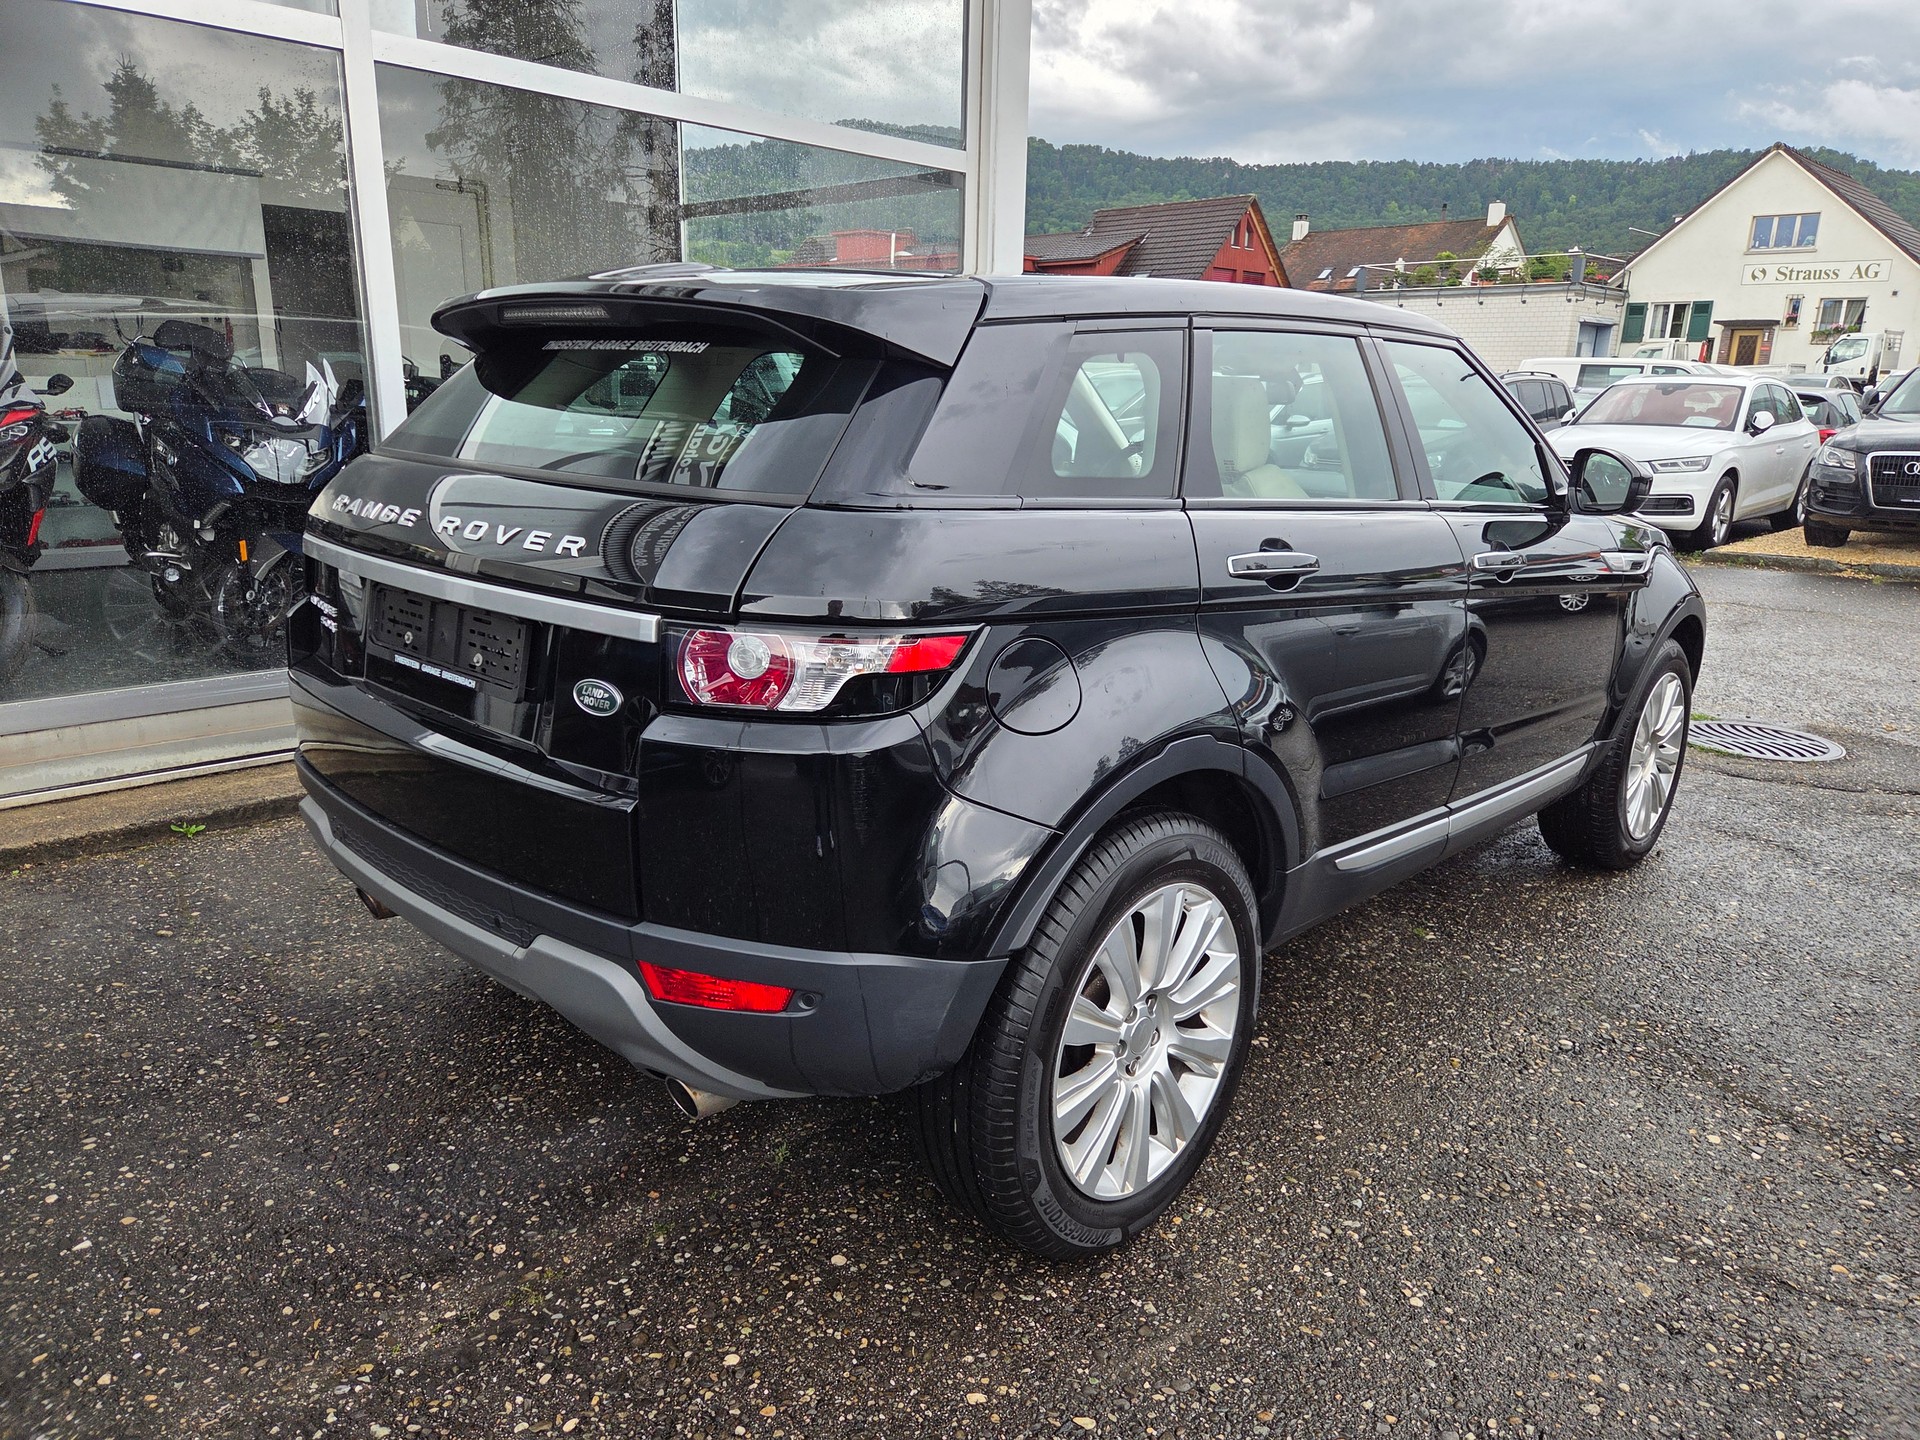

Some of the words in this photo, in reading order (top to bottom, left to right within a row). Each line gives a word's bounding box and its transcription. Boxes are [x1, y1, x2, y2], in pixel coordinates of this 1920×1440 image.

[1775, 265, 1840, 282] Strauss
[1849, 262, 1881, 280] AG
[591, 340, 635, 351] GARAGE
[629, 340, 710, 354] BREITENBACH
[332, 493, 423, 528] RANGE
[437, 515, 587, 558] ROVER
[581, 685, 604, 698] LAND
[583, 695, 611, 710] ROVER
[1203, 843, 1256, 913] BRIDGESTONE
[1026, 1066, 1039, 1151] TURANZA
[1037, 1193, 1114, 1247] BRIDGESTONE
